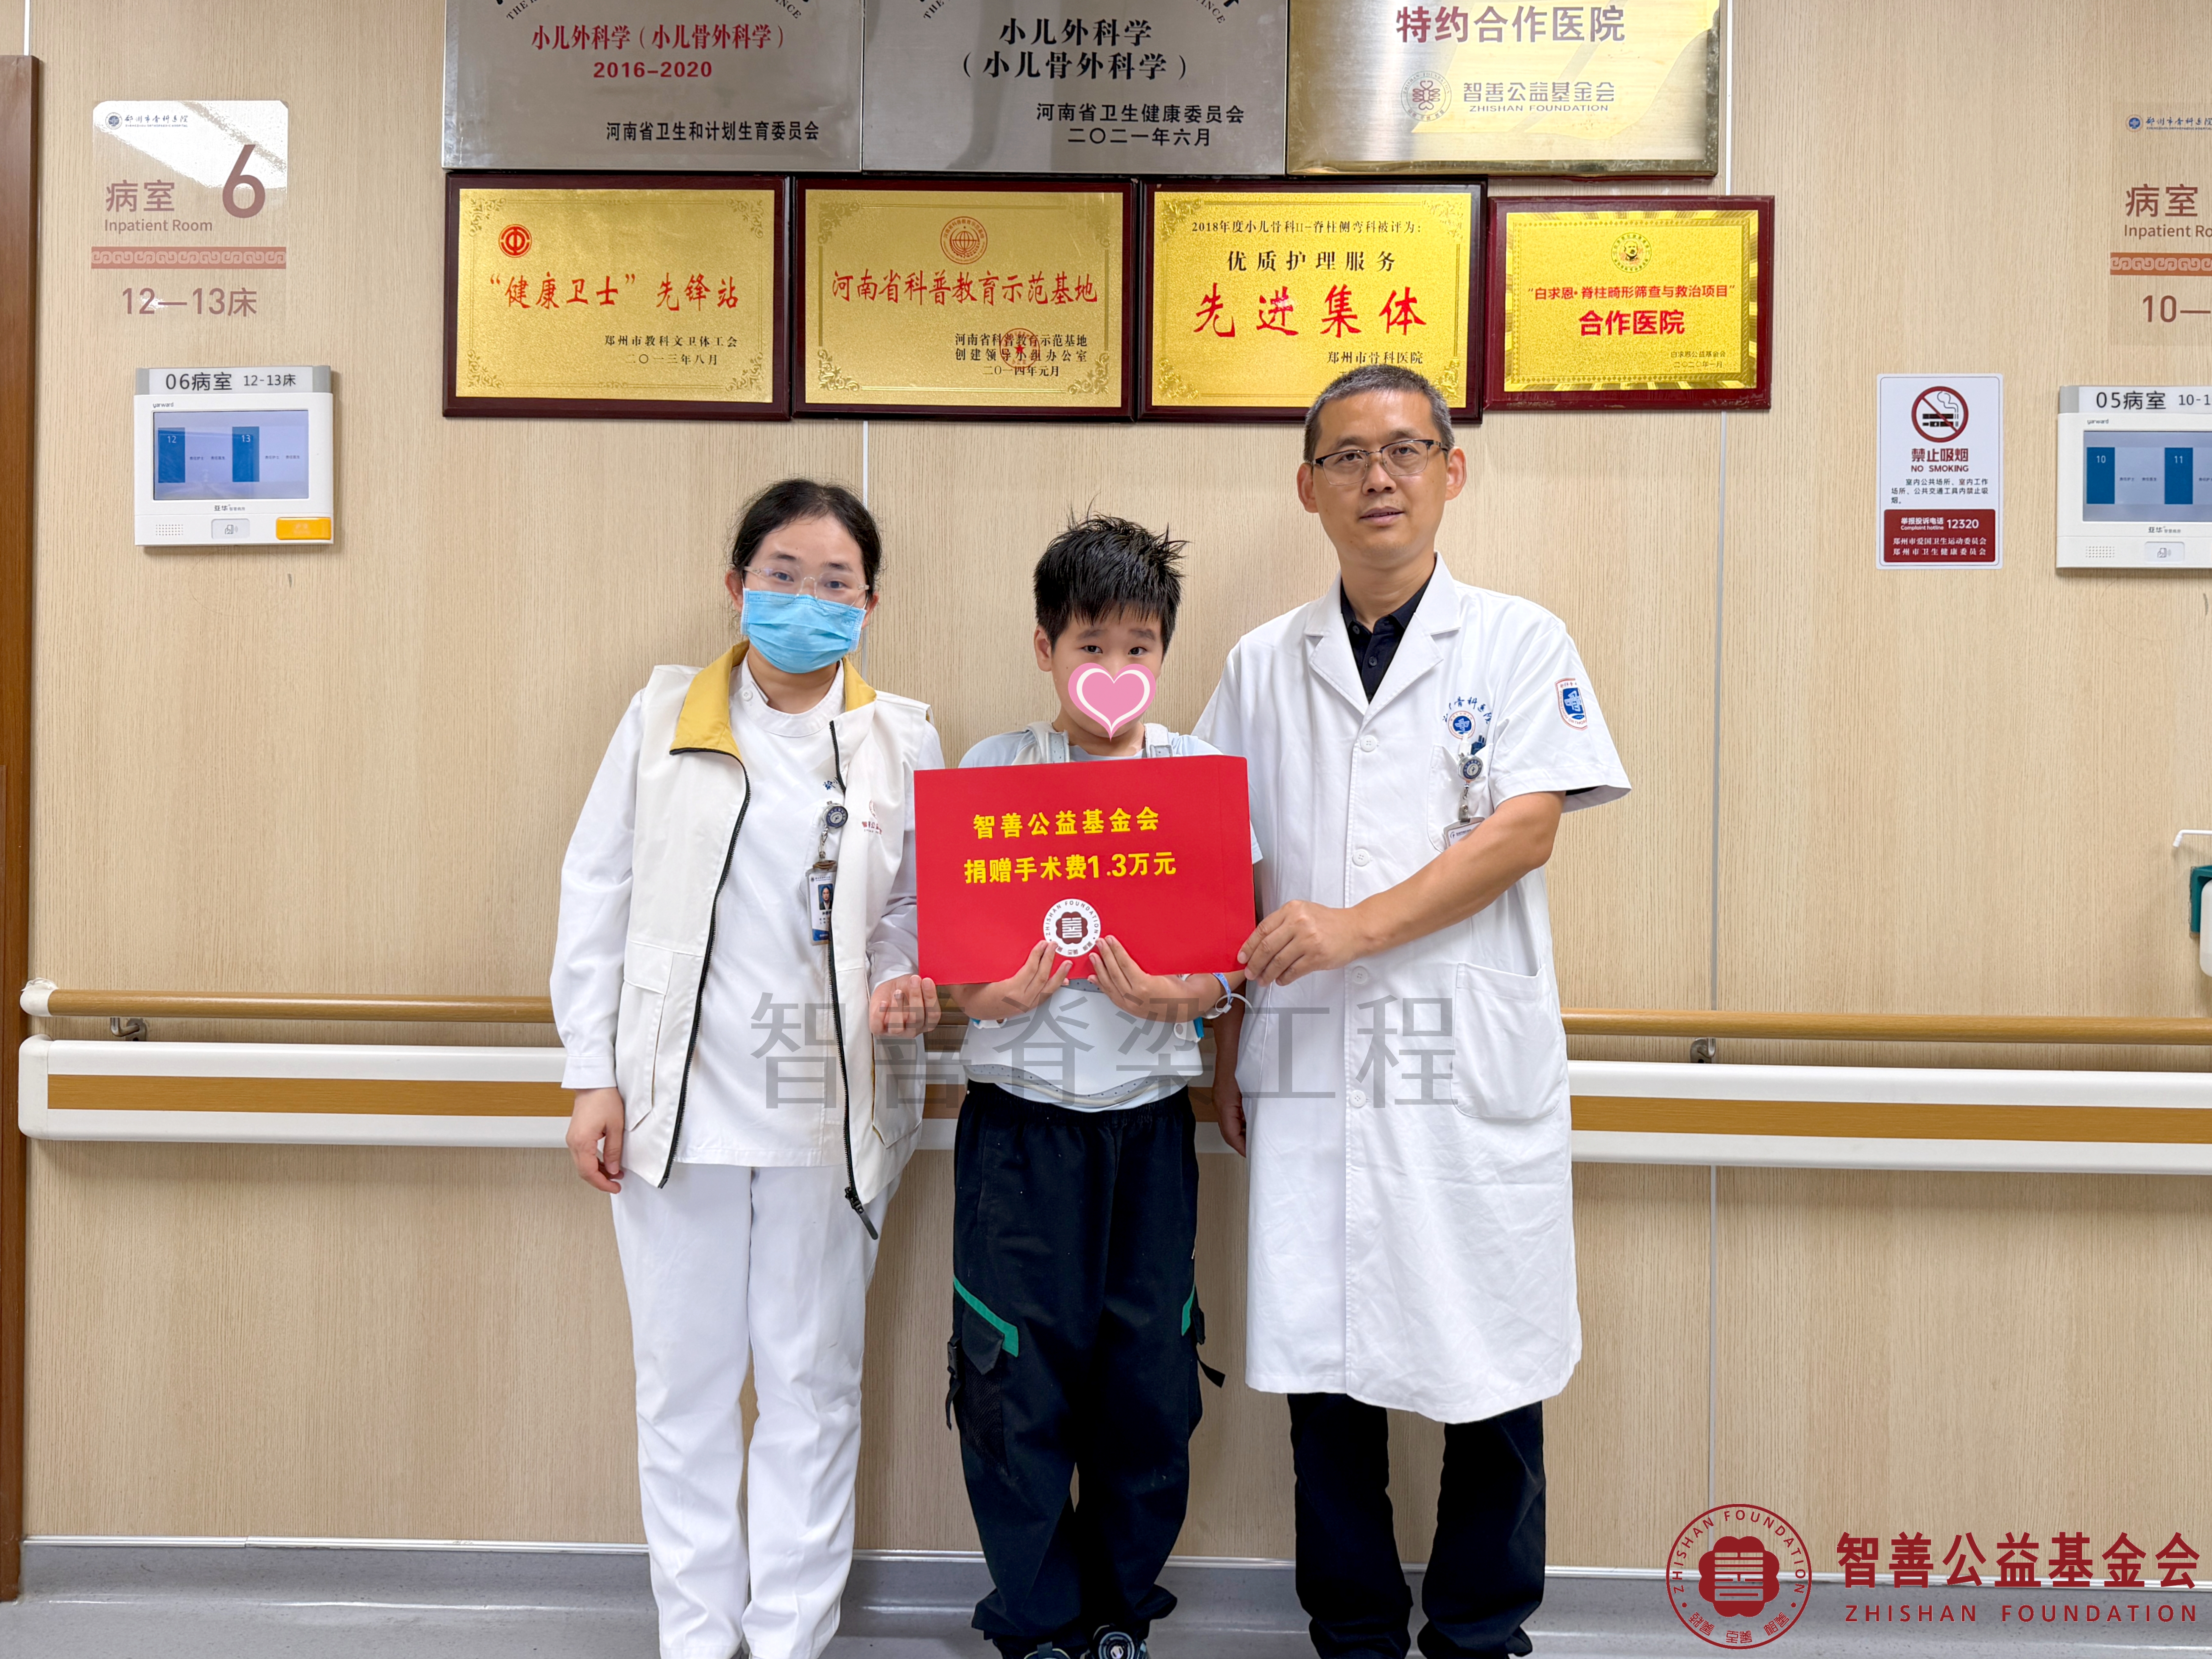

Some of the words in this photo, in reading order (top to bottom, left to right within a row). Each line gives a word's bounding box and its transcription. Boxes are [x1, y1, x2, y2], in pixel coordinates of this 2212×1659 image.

[999, 18, 1152, 47] 小儿外科学
[1396, 5, 1625, 43] 特约合作医院
[594, 61, 712, 78] 2016-2020
[1464, 82, 1615, 102] 智善公益基金会
[1036, 103, 1244, 124] 河南省卫生健康委员会
[606, 120, 819, 141] 河南省卫生和计划生育委员会
[222, 144, 266, 218] 6
[106, 180, 175, 212] 病室
[2126, 184, 2198, 217] 病室
[105, 220, 168, 234] Inpatient
[173, 220, 212, 231] Room
[2125, 225, 2191, 240] Inpatient
[1228, 250, 1396, 272] 优质护理服务
[832, 269, 1097, 306] 河南省科普教育示范基地
[1194, 282, 1427, 338] 先进集体
[1579, 309, 1685, 336] 合作医院
[605, 335, 737, 348] 郑州市教科文卫体工会
[955, 333, 1087, 347] 河南省科普教育示范基地
[955, 349, 1087, 362] 创建领导小组办公室
[1327, 351, 1423, 364] 郑州市骨科医院
[165, 372, 233, 391] 06病室
[243, 374, 296, 387] 12-13床
[2096, 390, 2166, 410] 05病室
[2179, 394, 2212, 405] 10-1
[167, 435, 176, 443] 12
[241, 435, 251, 443] 13
[1911, 448, 1969, 462] 禁止吸烟
[2096, 455, 2106, 463] 10
[1947, 519, 1979, 529] 12320
[1893, 537, 1987, 545] 郑州市爱国卫生运动委员会
[1893, 548, 1986, 556] 郑州市卫生健康委员会
[973, 806, 1159, 839] 智善公益基金会
[964, 851, 1177, 884] 捐赠手术费1.3万元
[1045, 903, 1061, 936] ZHISHAN
[1065, 901, 1099, 934] FOUNDATION
